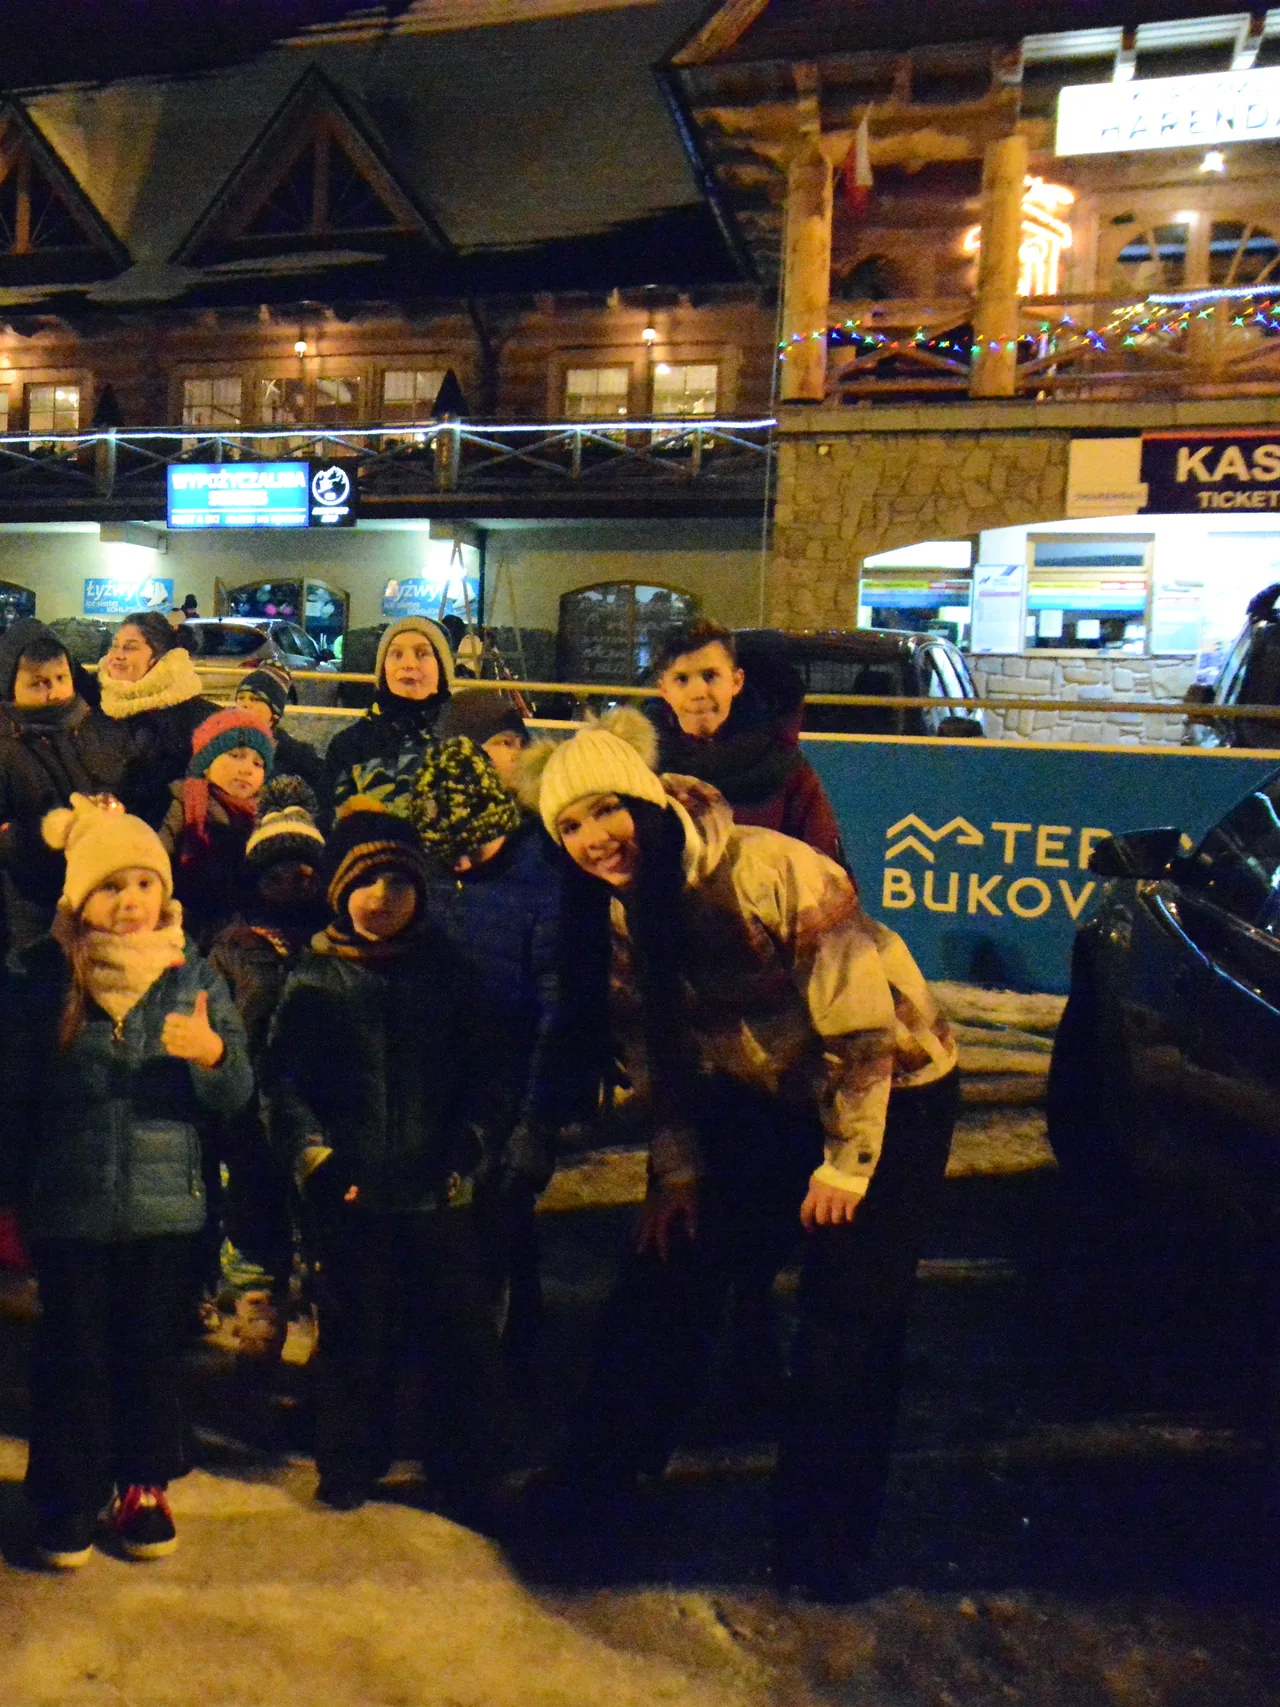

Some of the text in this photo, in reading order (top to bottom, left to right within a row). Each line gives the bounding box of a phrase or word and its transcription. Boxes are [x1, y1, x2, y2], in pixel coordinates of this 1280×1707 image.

[1100, 103, 1280, 141] HAREND
[1175, 444, 1280, 483] KAS
[394, 580, 440, 602] yżwy
